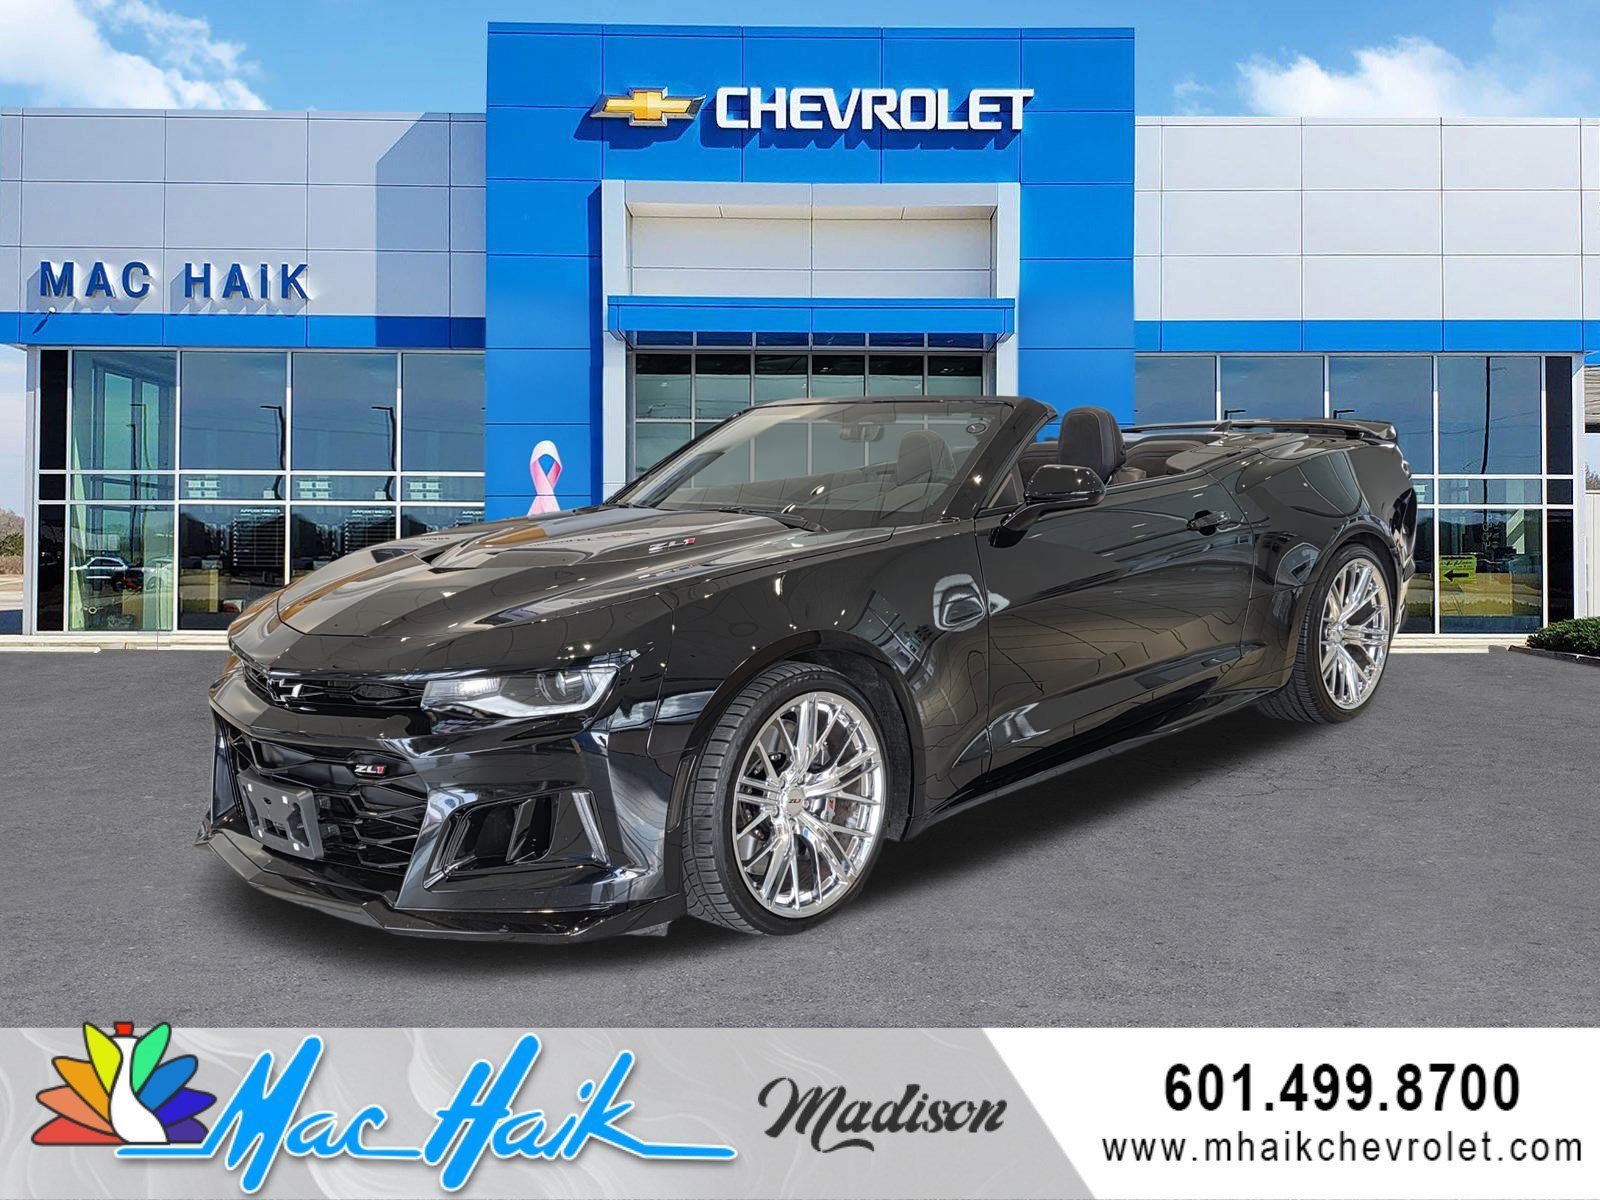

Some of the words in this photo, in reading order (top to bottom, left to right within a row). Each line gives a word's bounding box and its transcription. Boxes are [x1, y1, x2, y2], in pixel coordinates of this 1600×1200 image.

[715, 87, 1035, 131] CHEVROLET
[40, 261, 150, 298] MAC
[184, 262, 309, 299] HAIK
[354, 764, 386, 775] ZL1
